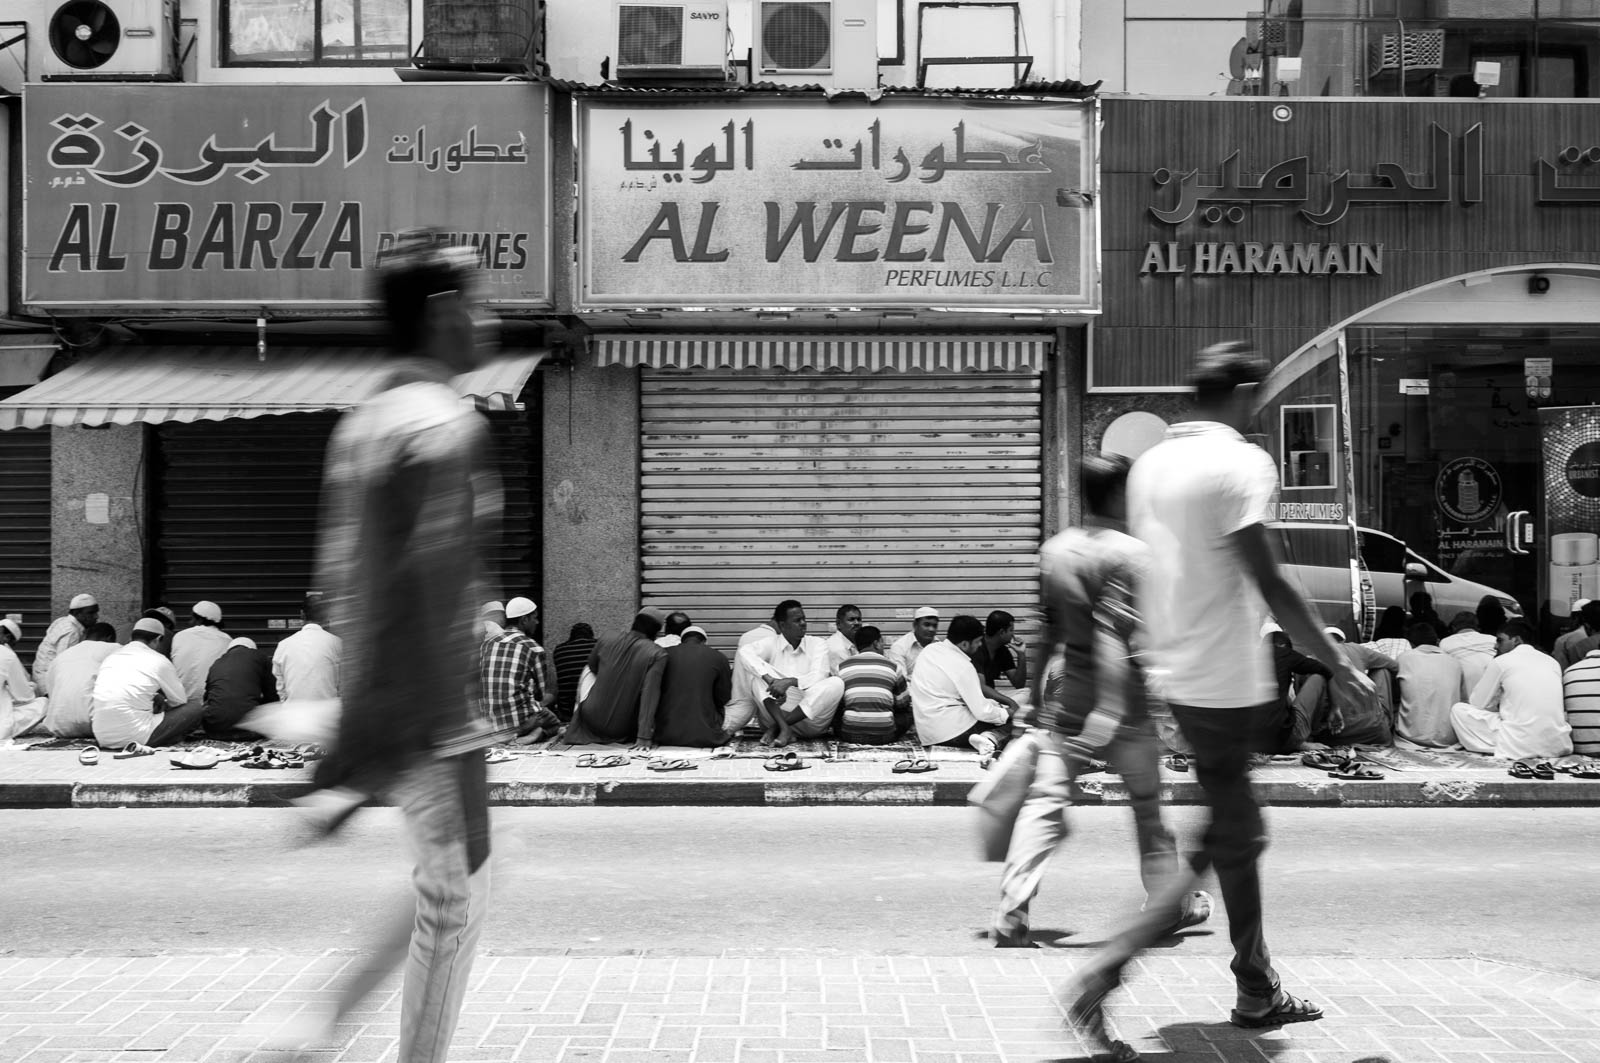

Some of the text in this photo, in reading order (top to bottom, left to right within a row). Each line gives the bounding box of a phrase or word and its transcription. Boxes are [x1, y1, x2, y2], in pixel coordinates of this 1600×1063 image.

[689, 12, 720, 20] SANYO
[47, 97, 528, 188] عطورات البرزة
[618, 117, 1053, 184] عطورات الوينا
[1149, 120, 1483, 225] الحرمين
[47, 201, 365, 273] AL BARZA
[375, 231, 530, 271] PFMES
[620, 201, 1054, 264] AL WEENA
[1140, 241, 1385, 275] AL HARAMAIN
[884, 269, 1052, 288] PERFUMES L.L.C
[1279, 502, 1344, 520] PERFUMES
[1437, 539, 1504, 550] AL HARAMAIN
